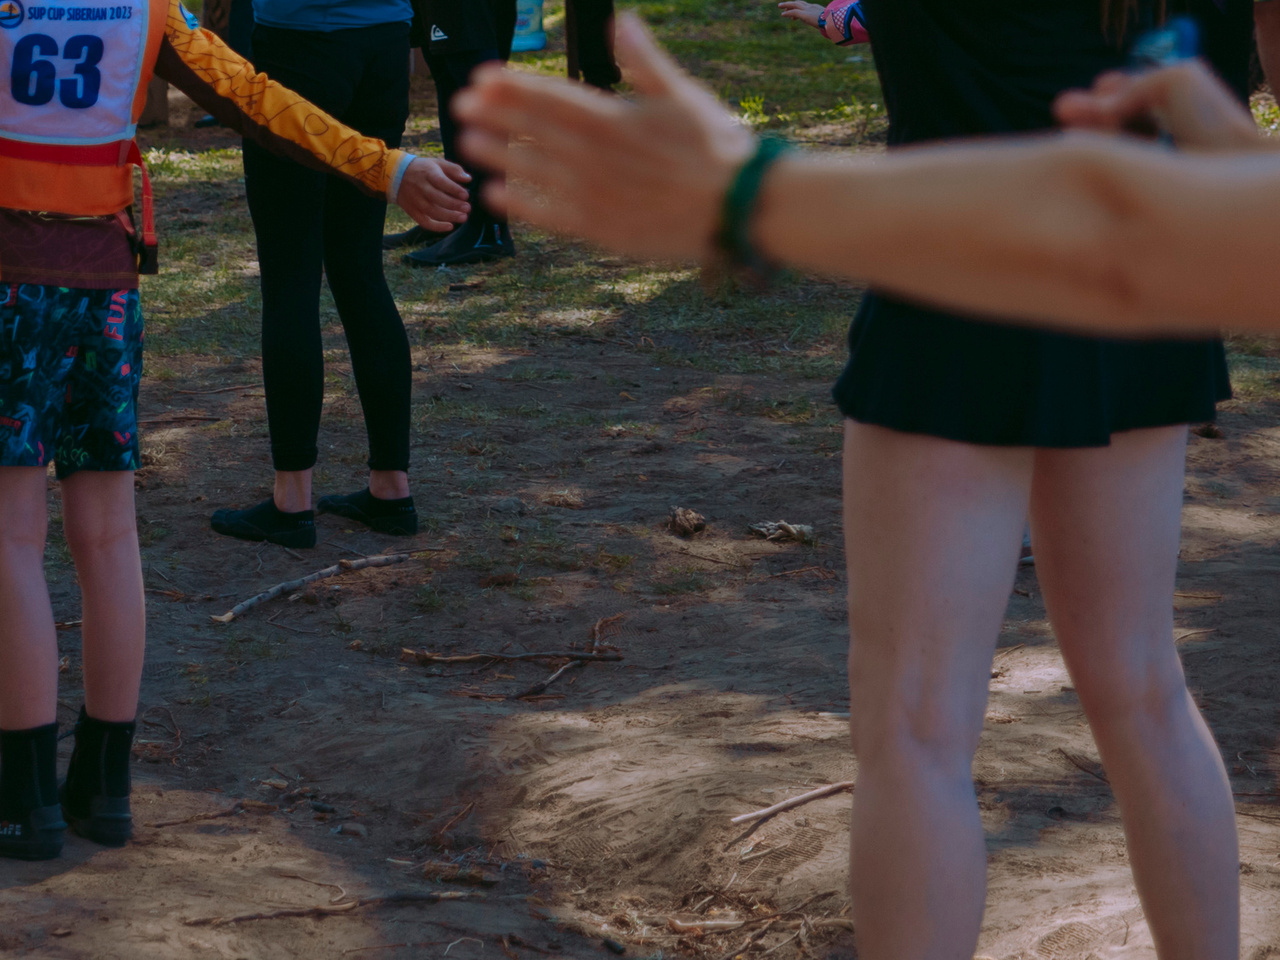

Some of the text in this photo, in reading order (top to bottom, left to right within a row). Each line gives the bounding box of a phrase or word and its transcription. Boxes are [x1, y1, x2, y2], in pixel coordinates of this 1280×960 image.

[28, 6, 133, 21] SUP CUP SIBERIAN 2023
[10, 33, 104, 109] 63
